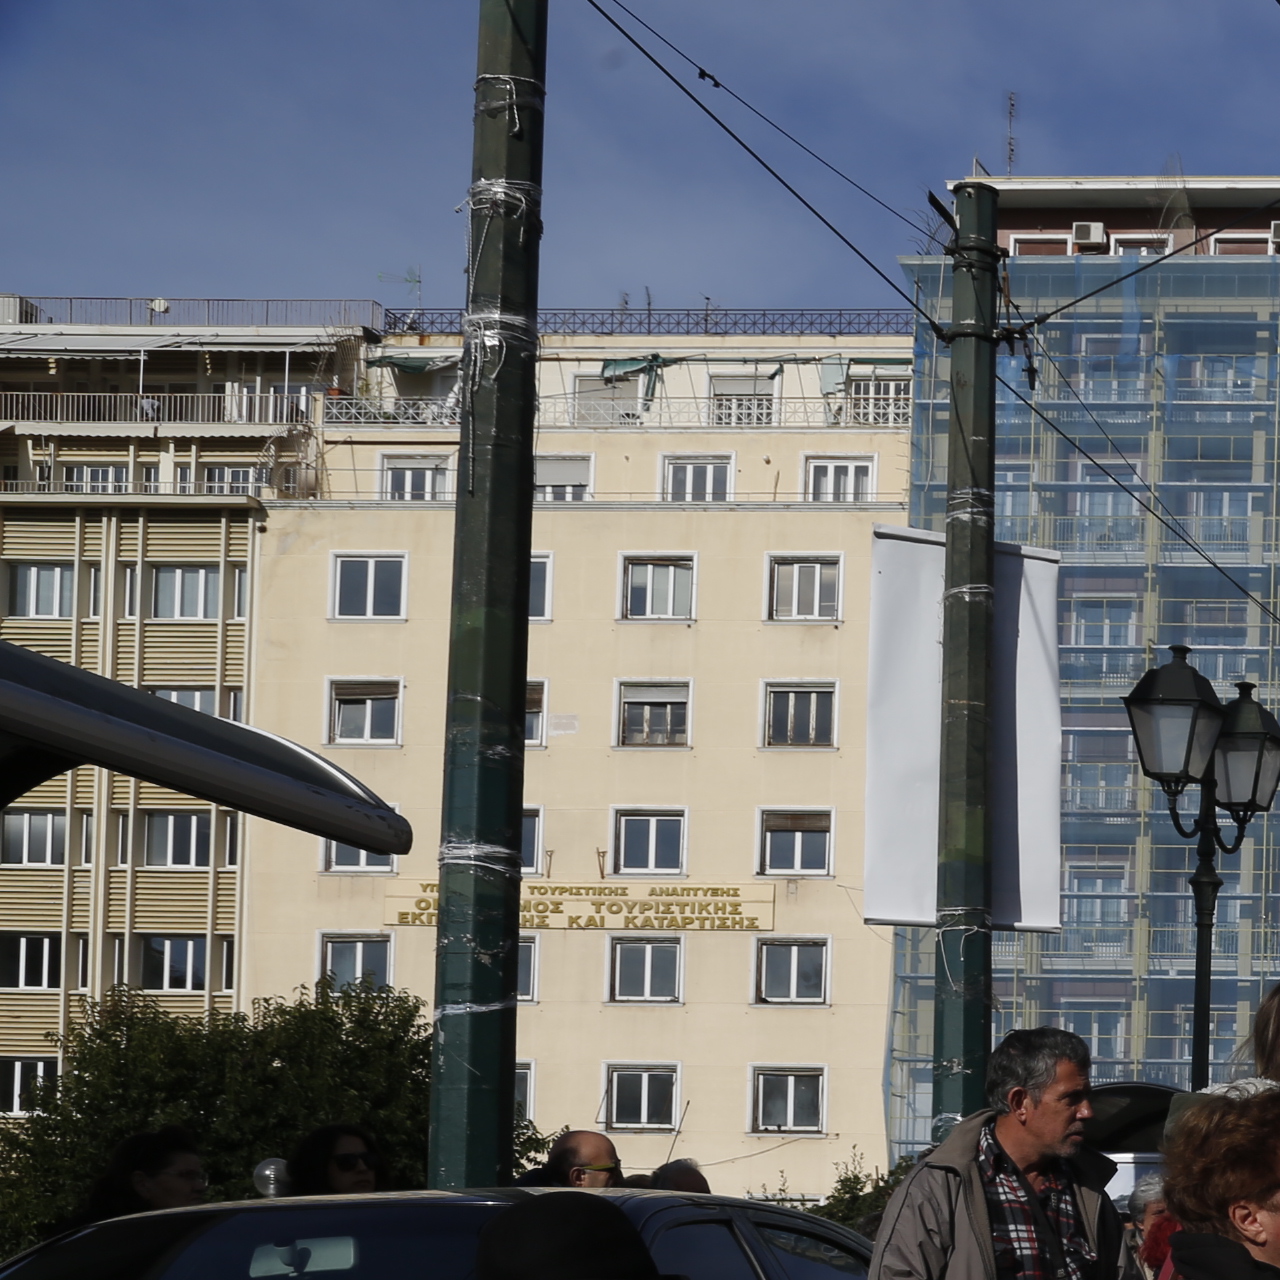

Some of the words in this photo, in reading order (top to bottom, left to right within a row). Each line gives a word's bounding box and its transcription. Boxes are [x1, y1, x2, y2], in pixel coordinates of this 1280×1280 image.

[527, 885, 629, 897] ΤΟΥΡΙΣΤΙΚΗΣ
[648, 886, 741, 898] ΑΝΑΠΤΥΞΗΣ
[591, 900, 743, 915] ΤΟΥΡΙΣΤΙΚΗΣ
[567, 915, 605, 928] ΚΑΙ
[624, 915, 760, 929] ΚΑΤΑΡΤΙΣΗΣ
